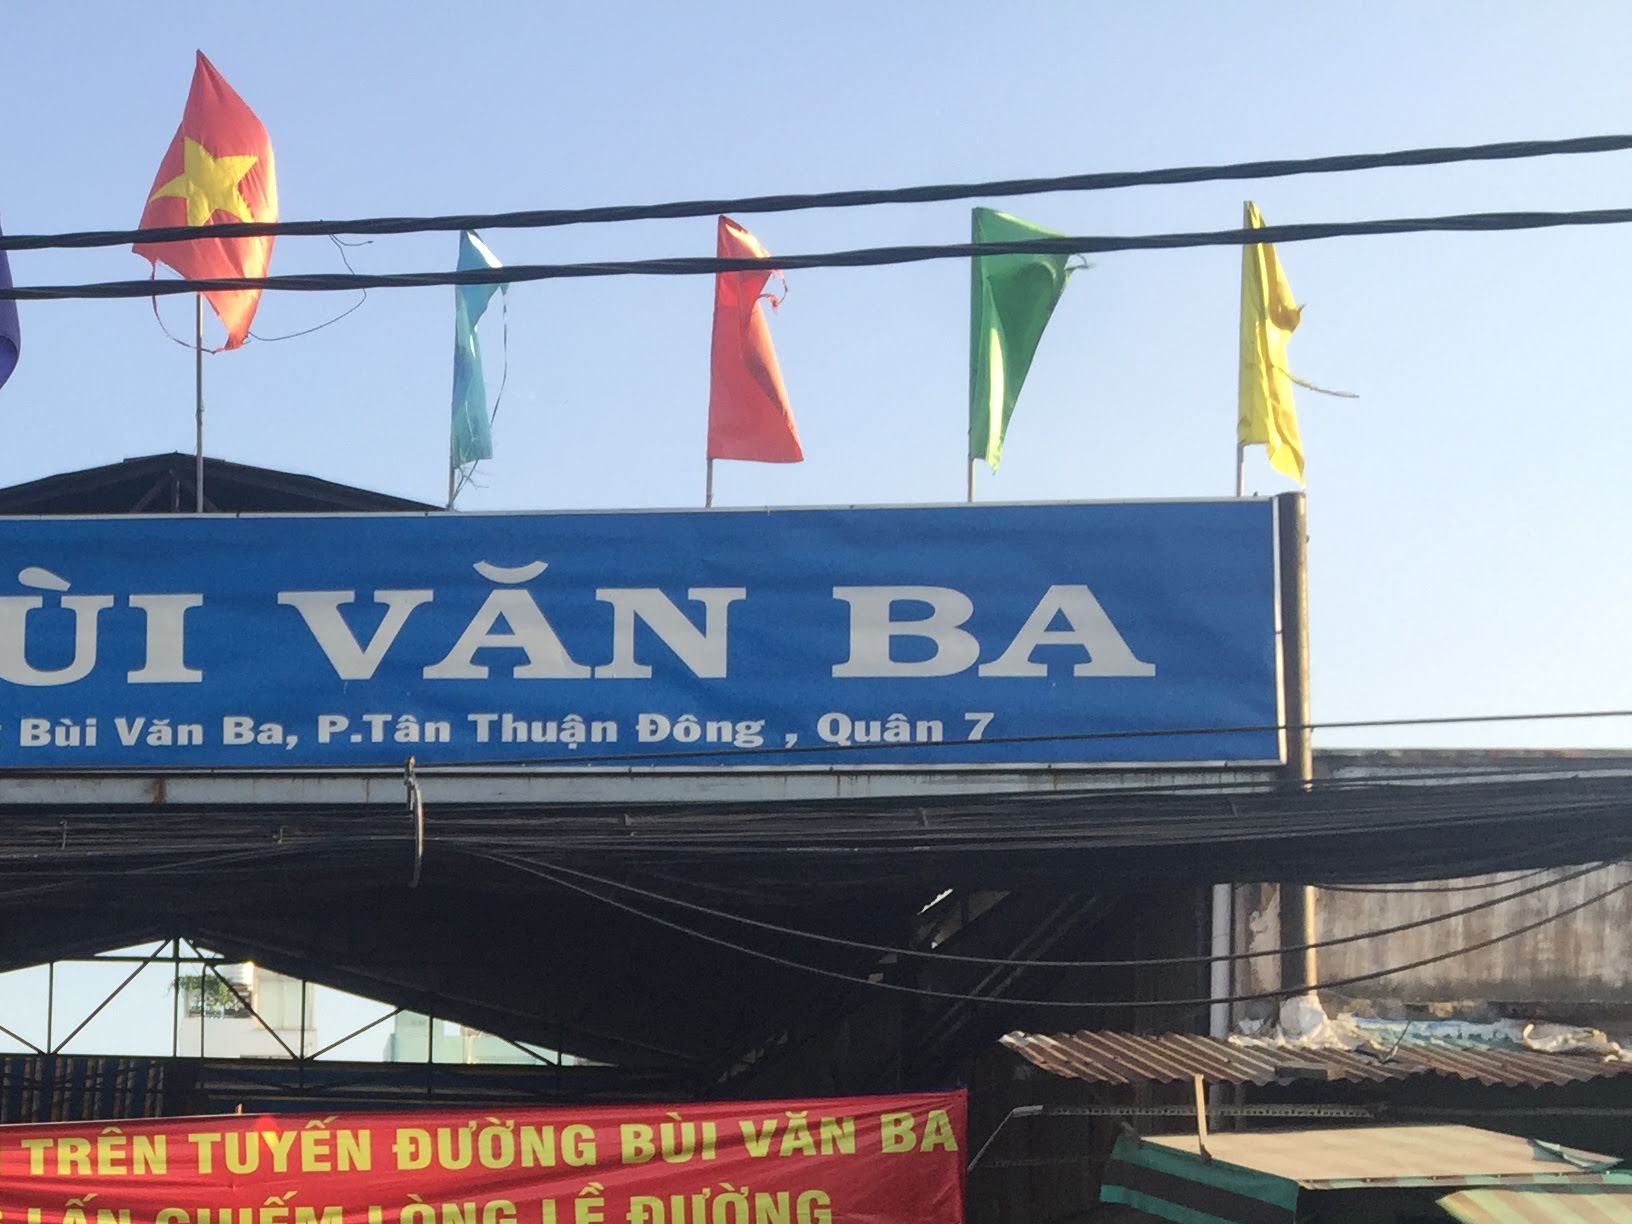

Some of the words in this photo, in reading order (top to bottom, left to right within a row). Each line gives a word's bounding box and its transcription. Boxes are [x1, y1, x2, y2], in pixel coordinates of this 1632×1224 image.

[277, 560, 747, 680] VĂN
[831, 584, 1156, 678] BA
[20, 718, 97, 747] Bùi
[114, 717, 203, 746] Văn
[223, 716, 298, 750] Ba,
[318, 714, 451, 743] P.Tân
[467, 713, 618, 749] Thuận
[635, 713, 765, 748] Đông
[964, 712, 994, 741] 7
[21, 1126, 167, 1175] TRÊN
[188, 1116, 372, 1175] TUYẾN
[391, 1116, 597, 1170] ĐƯỜNG
[620, 1111, 718, 1164] BÙI
[738, 1110, 856, 1158] VĂN
[880, 1109, 960, 1154] BA
